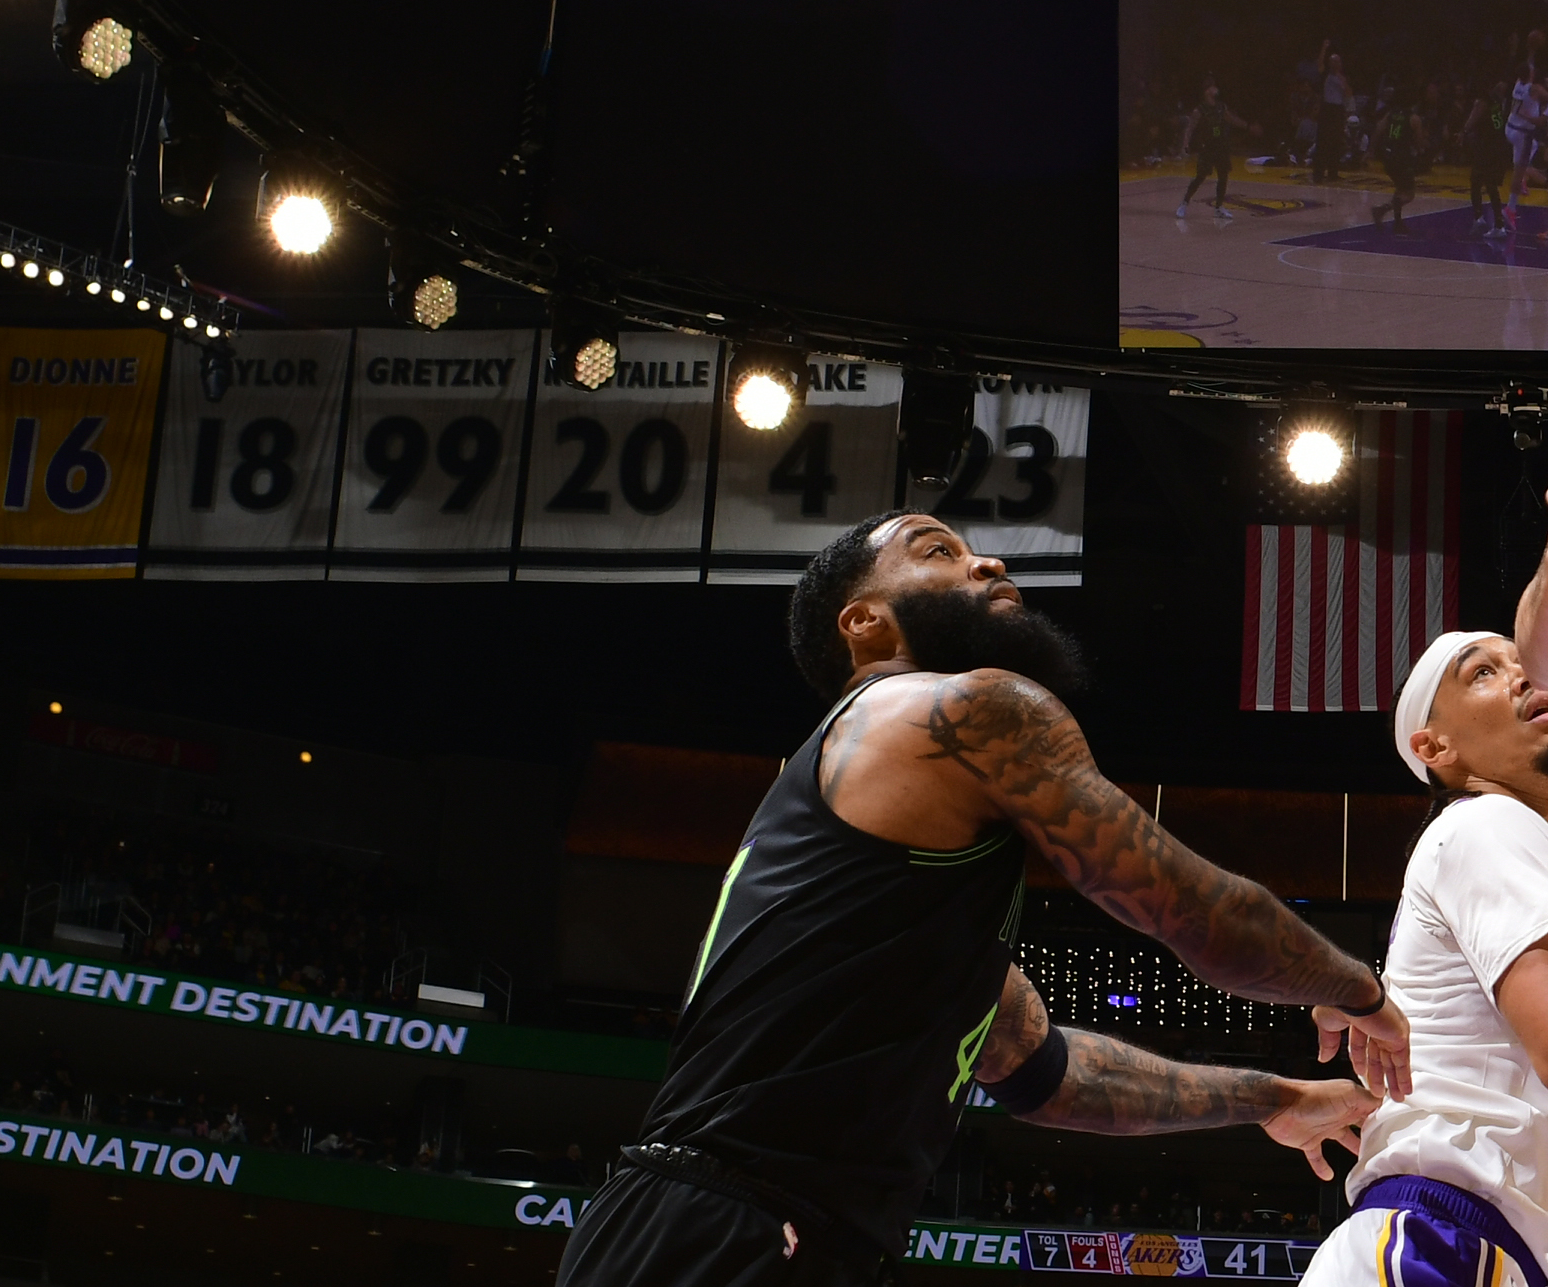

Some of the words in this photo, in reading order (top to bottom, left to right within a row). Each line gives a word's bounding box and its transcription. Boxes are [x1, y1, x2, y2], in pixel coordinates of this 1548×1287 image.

[8, 356, 140, 388] DIONNE
[366, 356, 516, 388] GRETZKY
[2, 414, 112, 513] 16
[189, 416, 297, 512] 18
[363, 415, 504, 514] 99
[544, 417, 690, 514] 20
[768, 422, 837, 516] 4
[952, 424, 1060, 522] 23
[171, 982, 470, 1054] DESTINATION
[1037, 1234, 1058, 1246] TOL
[1045, 1245, 1058, 1266] 7
[1071, 1235, 1104, 1247] FOULS
[1082, 1248, 1097, 1268] 4
[1122, 1238, 1201, 1274] LAKERS
[1222, 1241, 1268, 1274] 41
